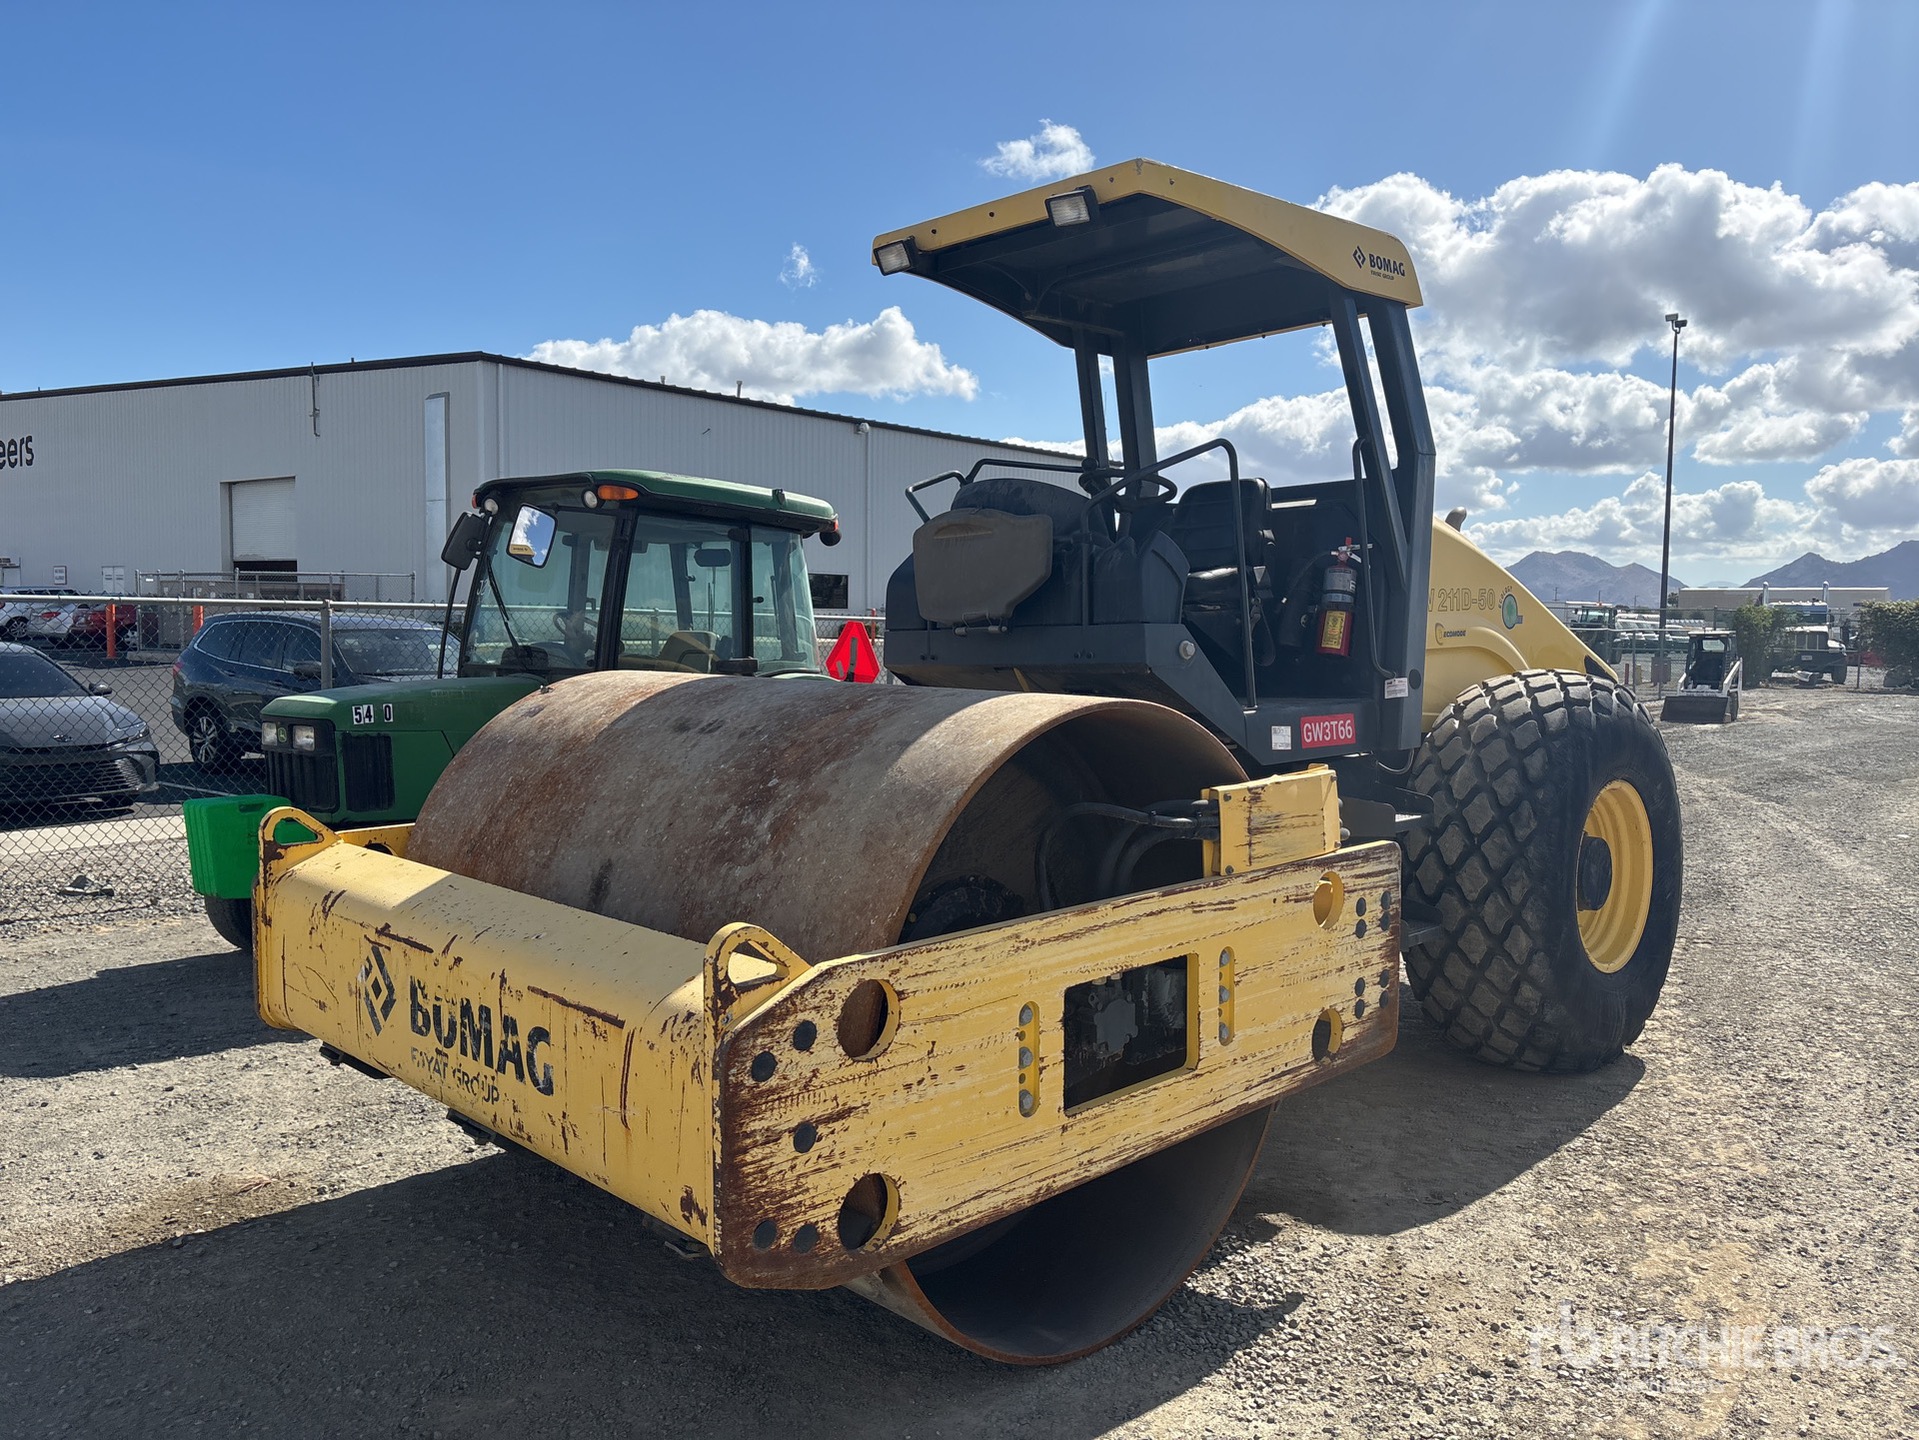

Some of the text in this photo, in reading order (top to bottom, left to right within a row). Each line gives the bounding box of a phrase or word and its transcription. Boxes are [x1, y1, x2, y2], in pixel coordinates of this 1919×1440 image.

[1368, 253, 1406, 277] BOMAG
[1437, 587, 1495, 612] 211D-50
[1303, 719, 1353, 743] GW3T66
[409, 974, 555, 1097] BOMAG
